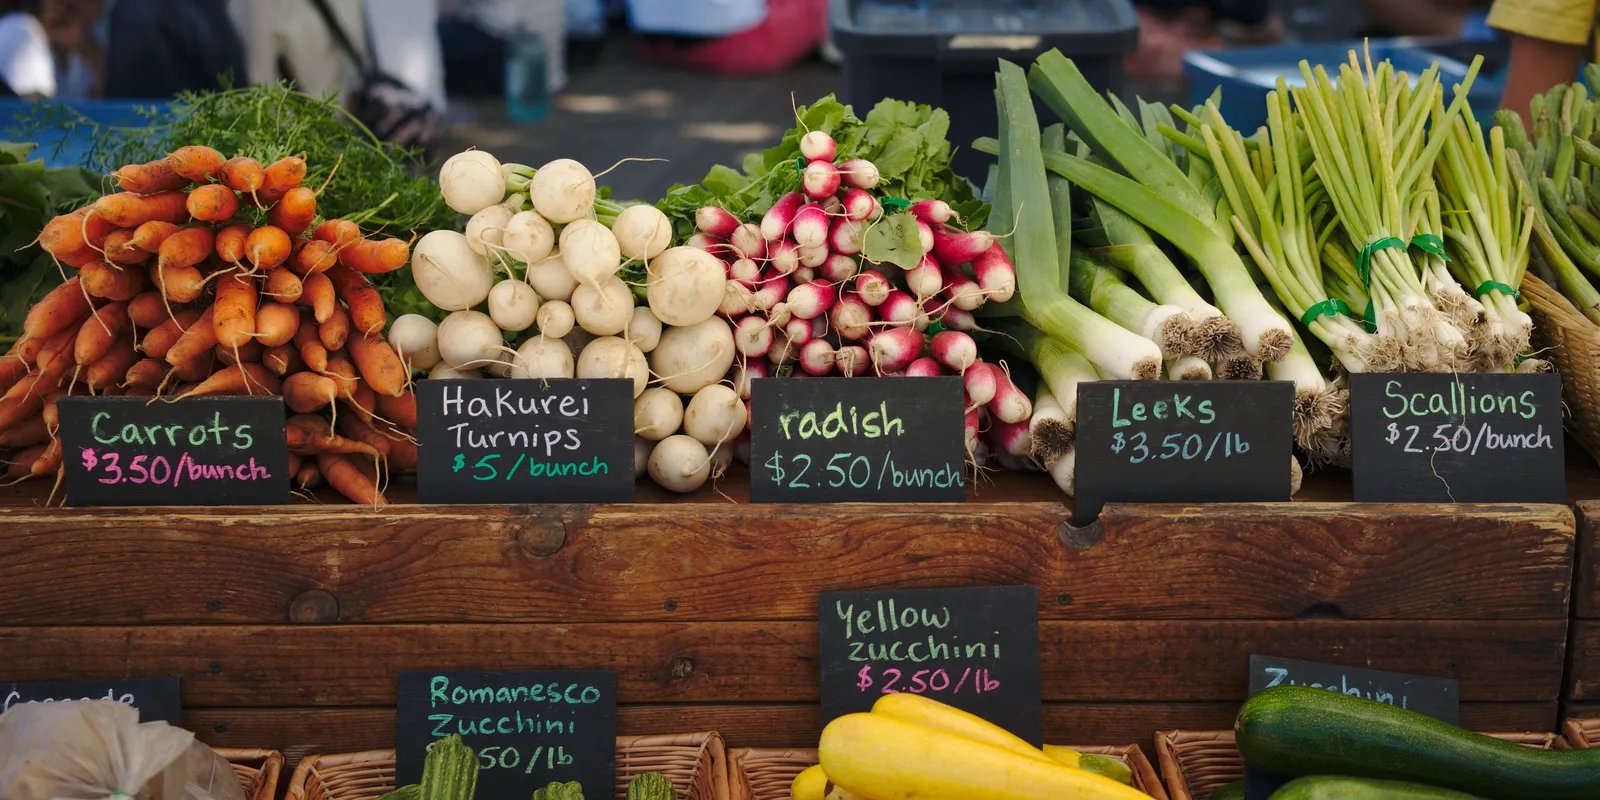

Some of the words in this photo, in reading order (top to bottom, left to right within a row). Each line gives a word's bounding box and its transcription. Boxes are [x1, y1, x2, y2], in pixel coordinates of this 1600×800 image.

[1382, 380, 1537, 419] Scallions
[91, 411, 253, 449] Carrots
[779, 400, 905, 440] radish
[447, 422, 581, 456] Turnips
[1111, 431, 1250, 463] $3.50/lb
[1385, 422, 1553, 455] $2.50/bunch
[81, 447, 272, 487] $3.50/bunch
[764, 450, 964, 490] $2.50/bunch
[836, 598, 950, 639] Yellow
[847, 630, 1000, 662] zucchini
[430, 675, 601, 708] Romanesco
[427, 710, 575, 737] Zucchini
